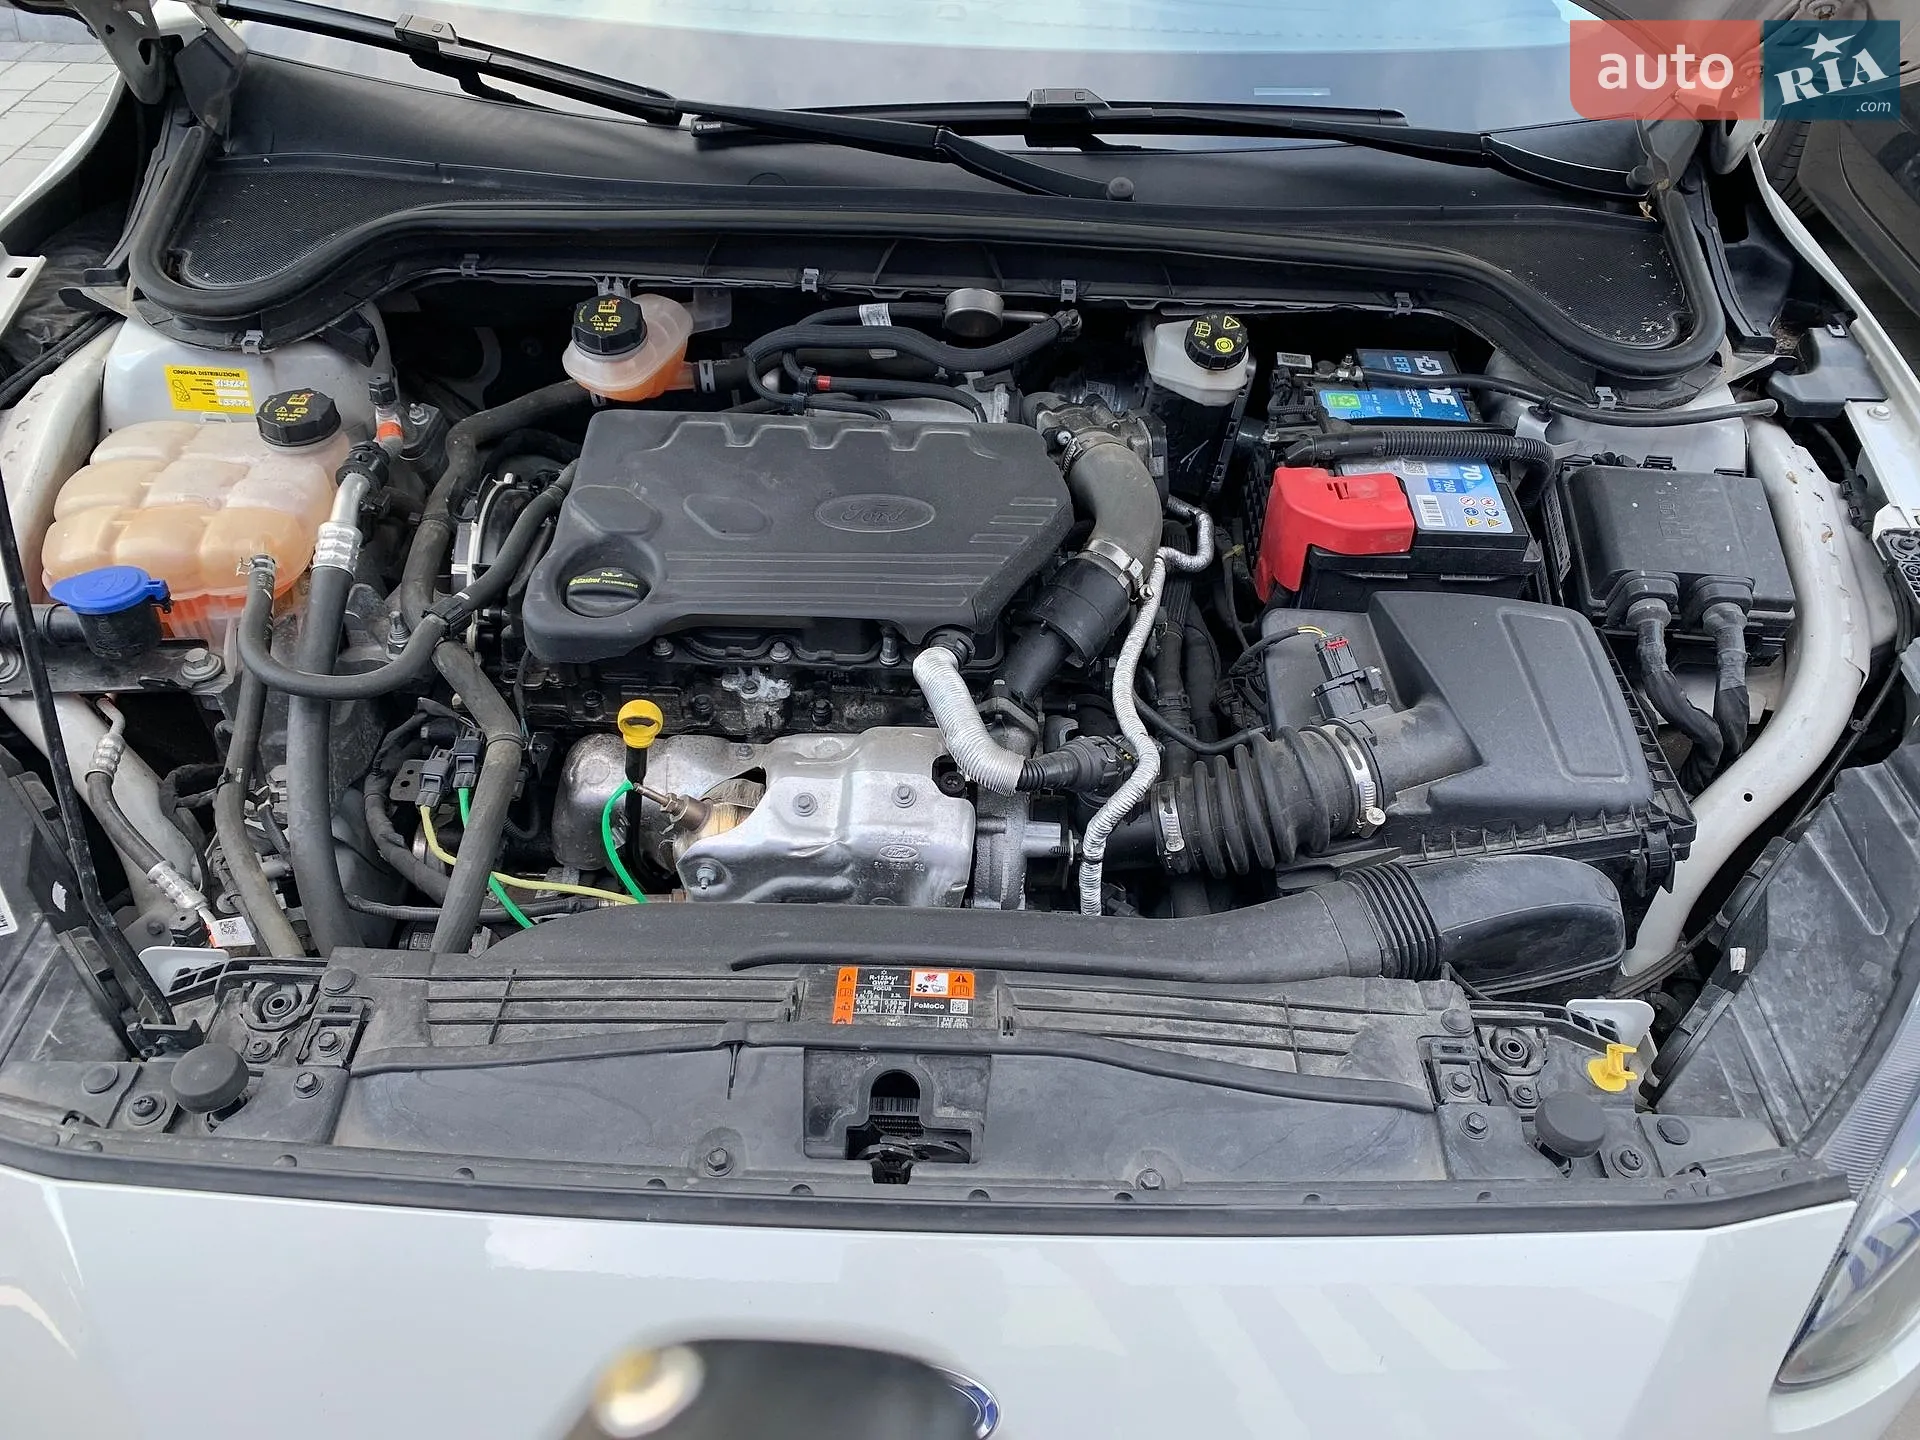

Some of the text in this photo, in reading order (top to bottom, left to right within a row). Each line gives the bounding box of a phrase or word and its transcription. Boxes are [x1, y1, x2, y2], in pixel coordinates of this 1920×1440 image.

[198, 370, 241, 378] DISTRIBUZIONE
[1460, 465, 1484, 481] 70
[840, 503, 908, 522] Ford
[869, 974, 899, 982] R-1234yf
[913, 1002, 945, 1010] FoMoCo
